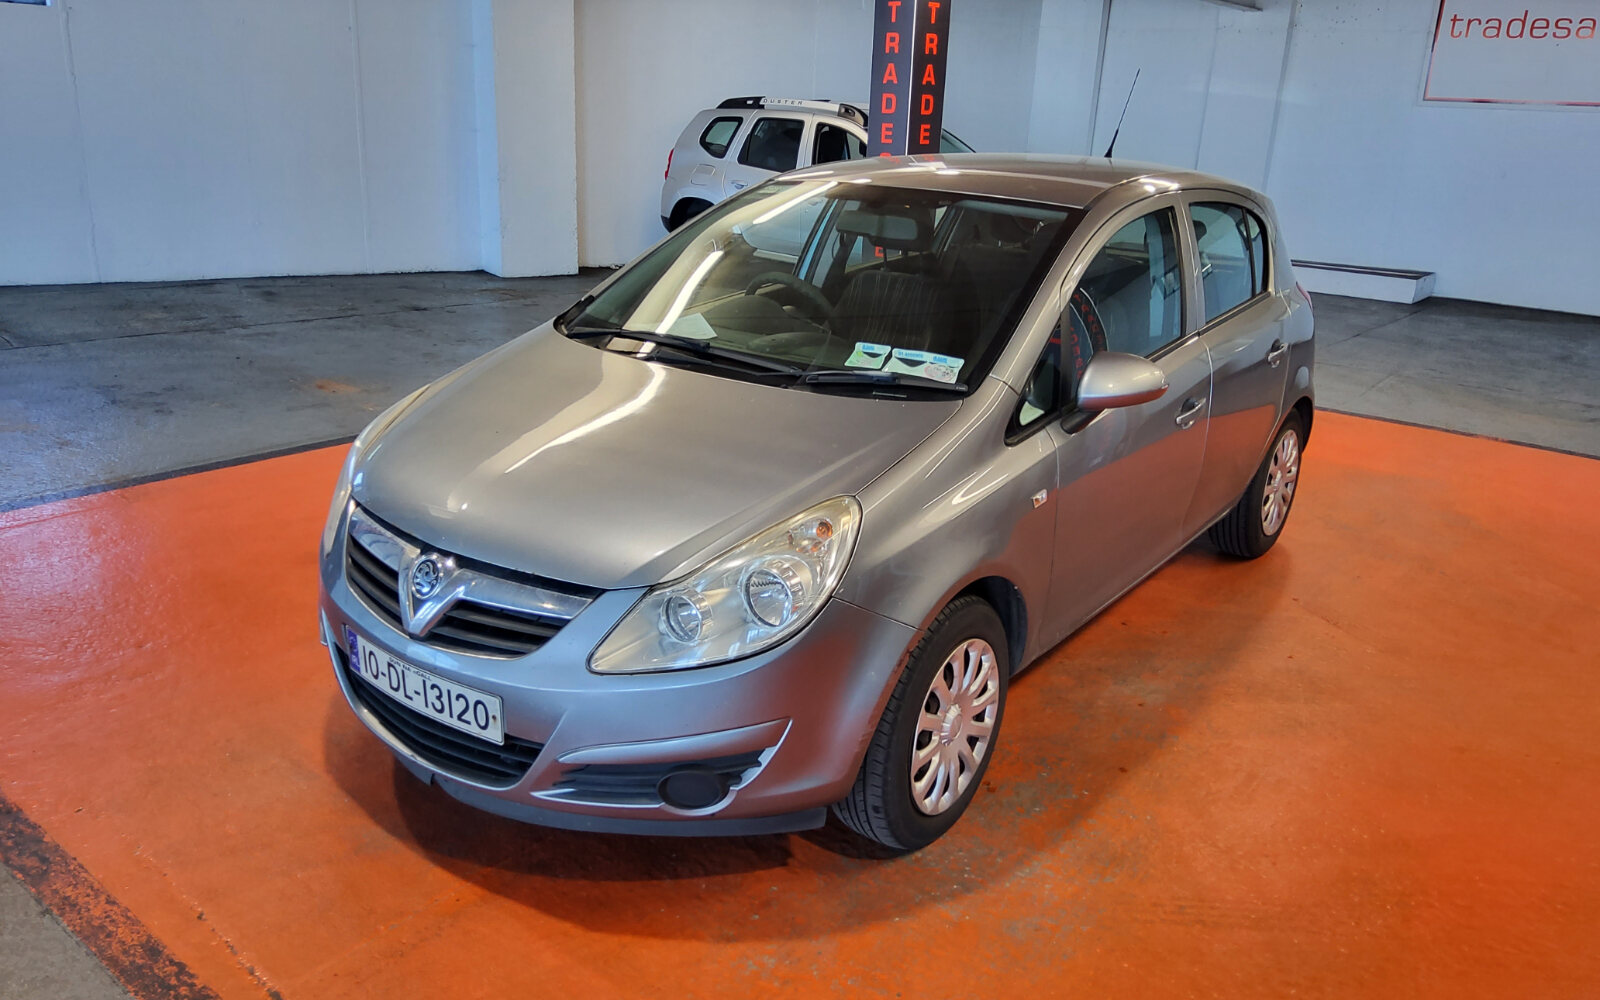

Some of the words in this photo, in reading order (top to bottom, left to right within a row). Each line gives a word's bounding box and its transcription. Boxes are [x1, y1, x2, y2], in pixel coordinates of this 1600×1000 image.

[879, 1, 902, 158] TRADE
[919, 2, 940, 145] TRADE
[1450, 10, 1597, 39] tradesa
[362, 645, 490, 731] 10-DL-13120
